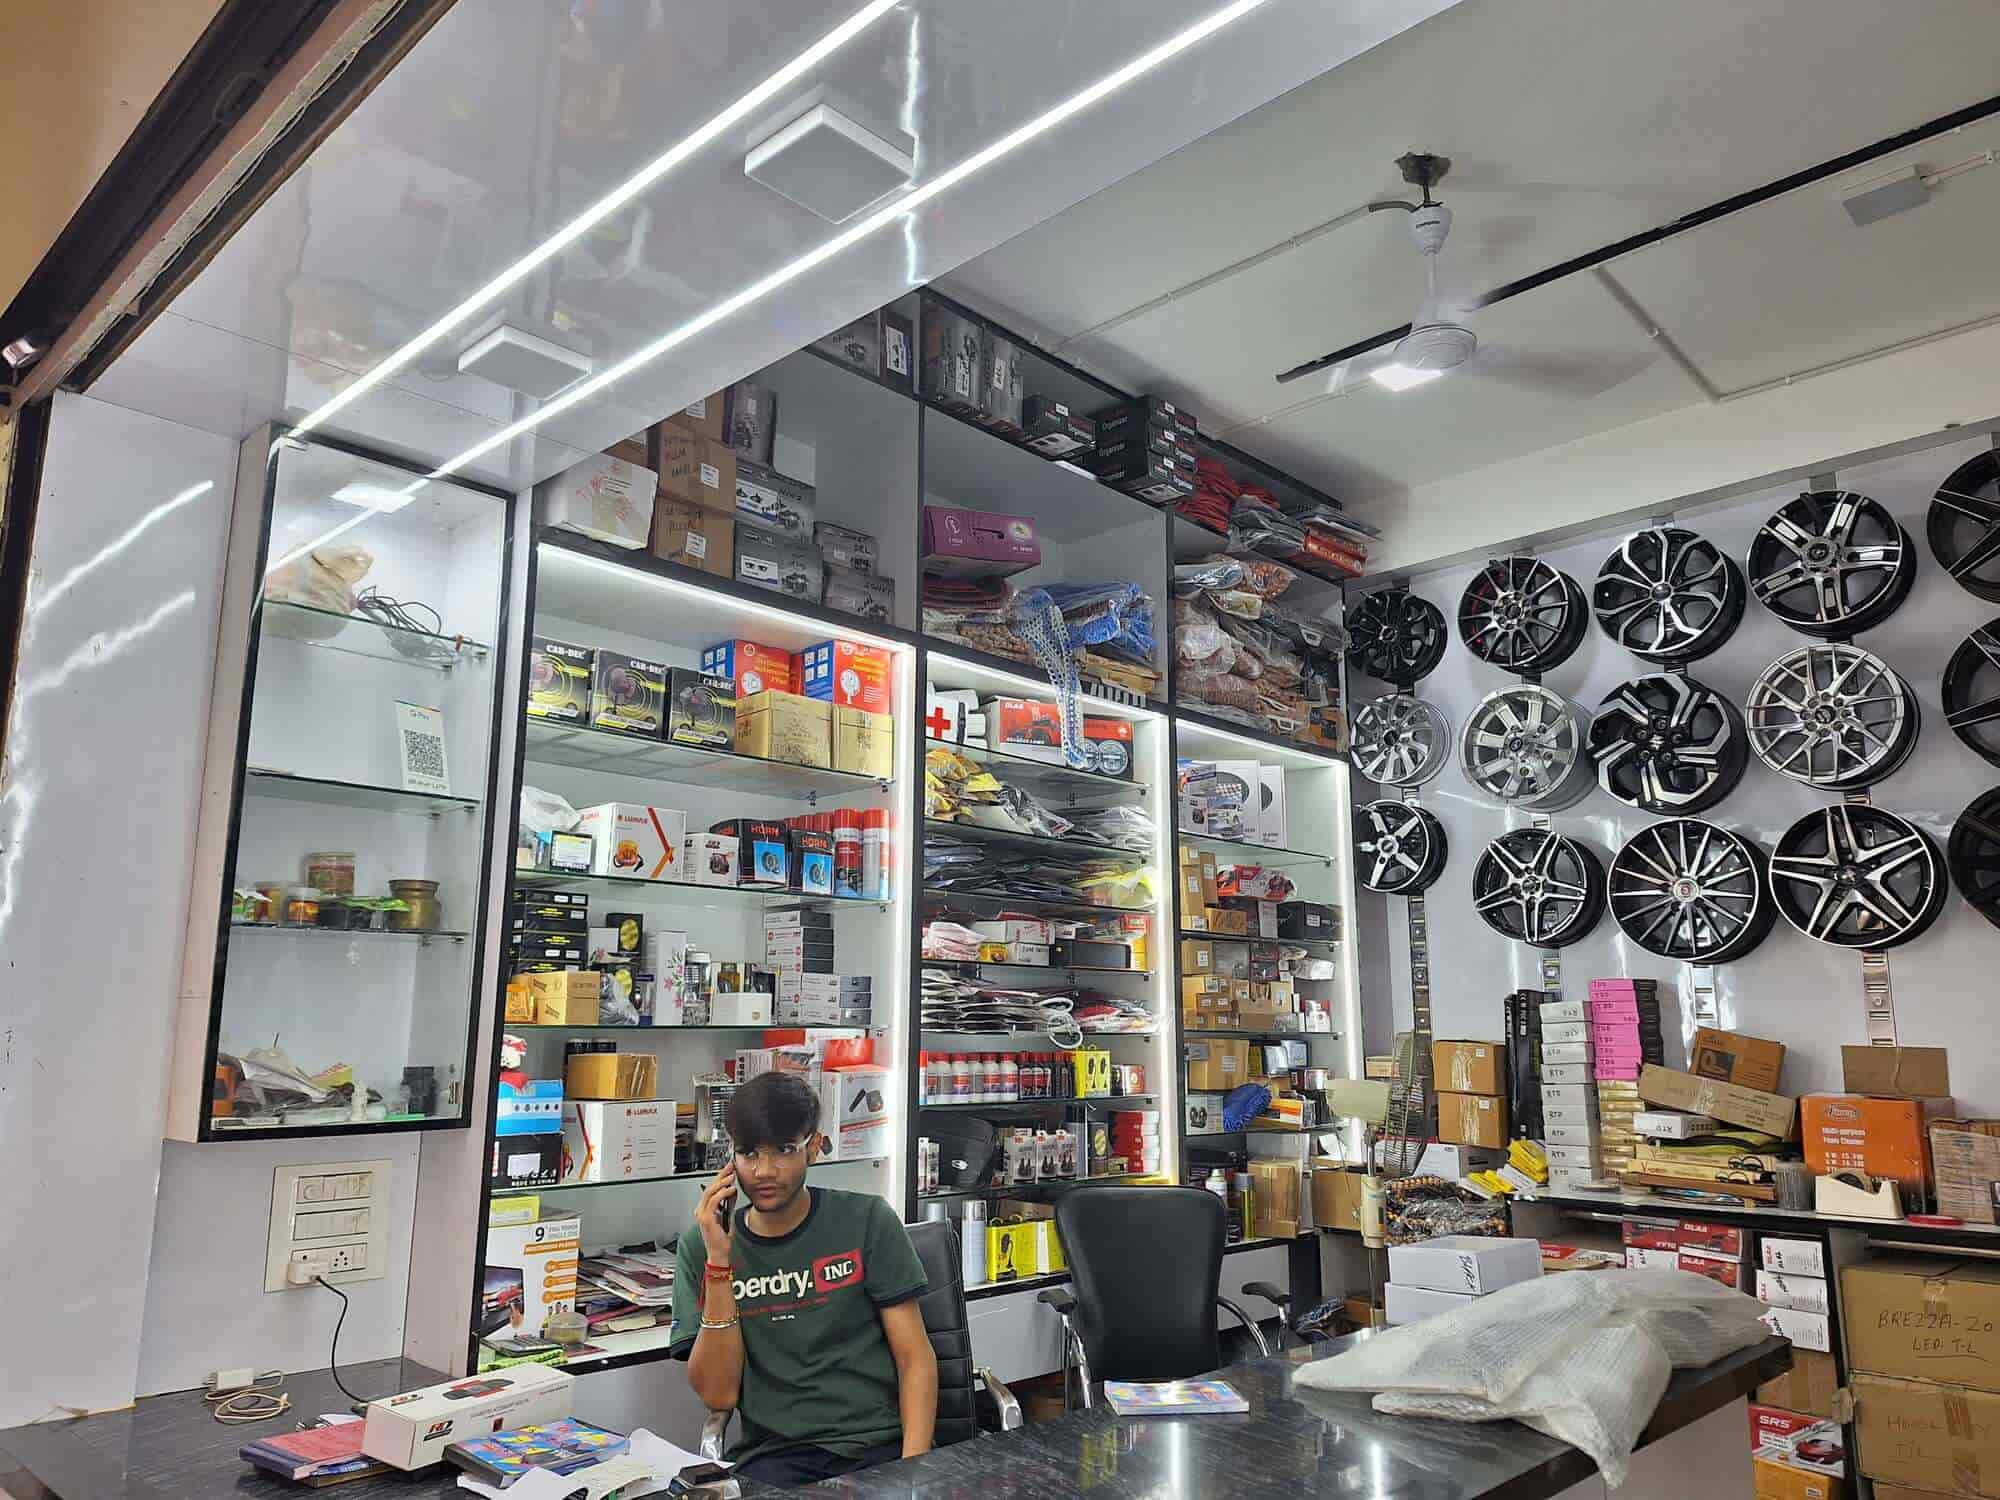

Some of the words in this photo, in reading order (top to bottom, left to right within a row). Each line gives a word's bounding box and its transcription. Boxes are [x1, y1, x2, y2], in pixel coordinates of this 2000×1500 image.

[751, 825, 780, 836] HORN
[801, 837, 828, 848] HORN
[535, 1227, 545, 1242] 9
[823, 1260, 855, 1281] INC
[1759, 1415, 1791, 1429] SRS
